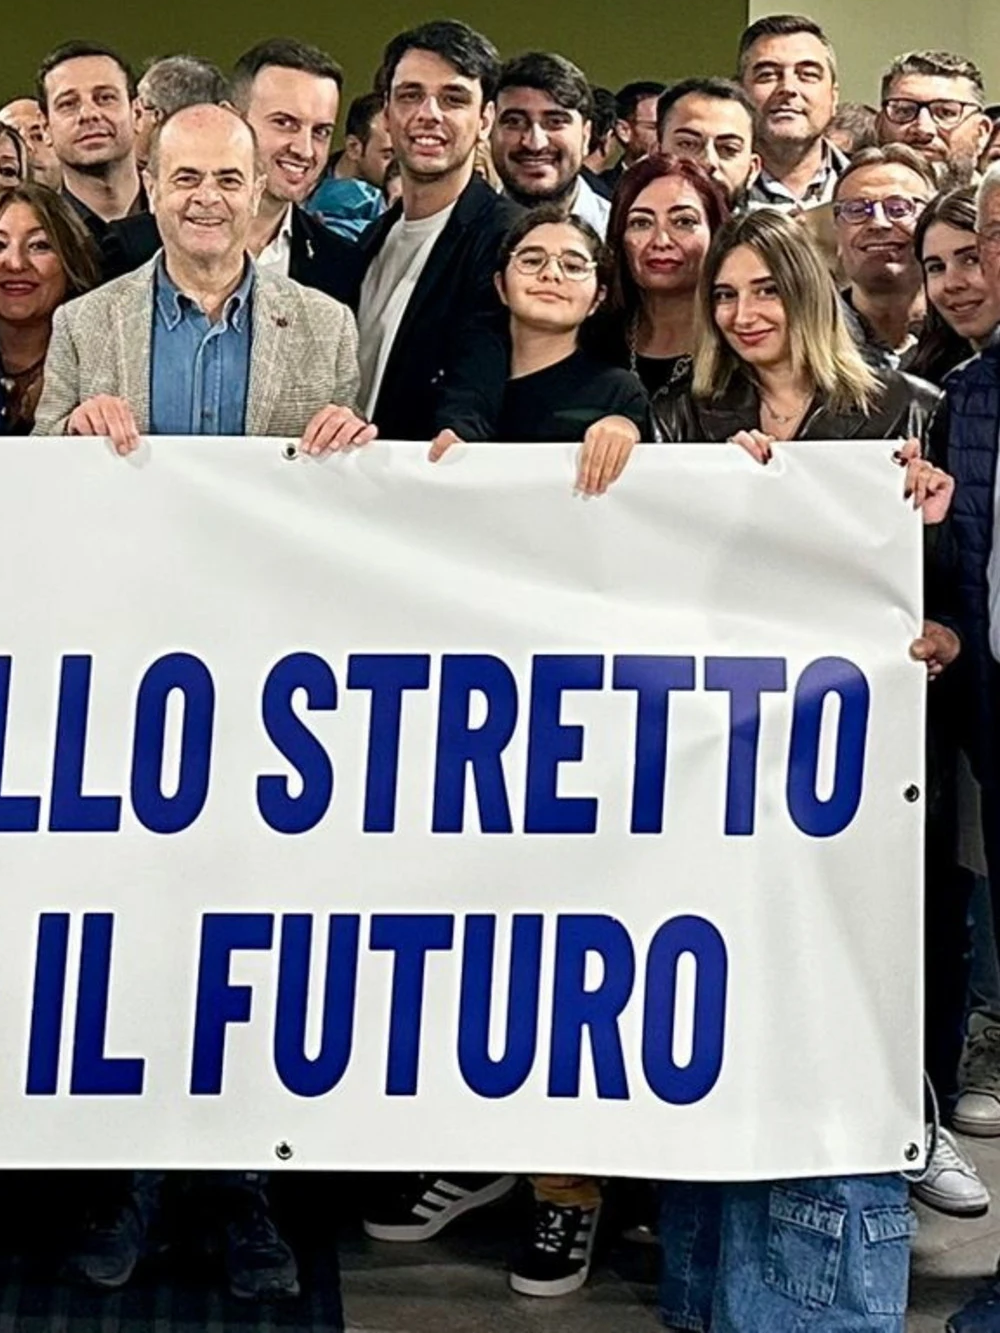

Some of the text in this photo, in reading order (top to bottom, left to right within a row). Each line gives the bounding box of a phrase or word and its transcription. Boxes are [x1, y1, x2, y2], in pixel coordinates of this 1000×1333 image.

[256, 651, 871, 838] STRETTO
[25, 912, 145, 1095] IL
[189, 912, 729, 1105] FUTURO
